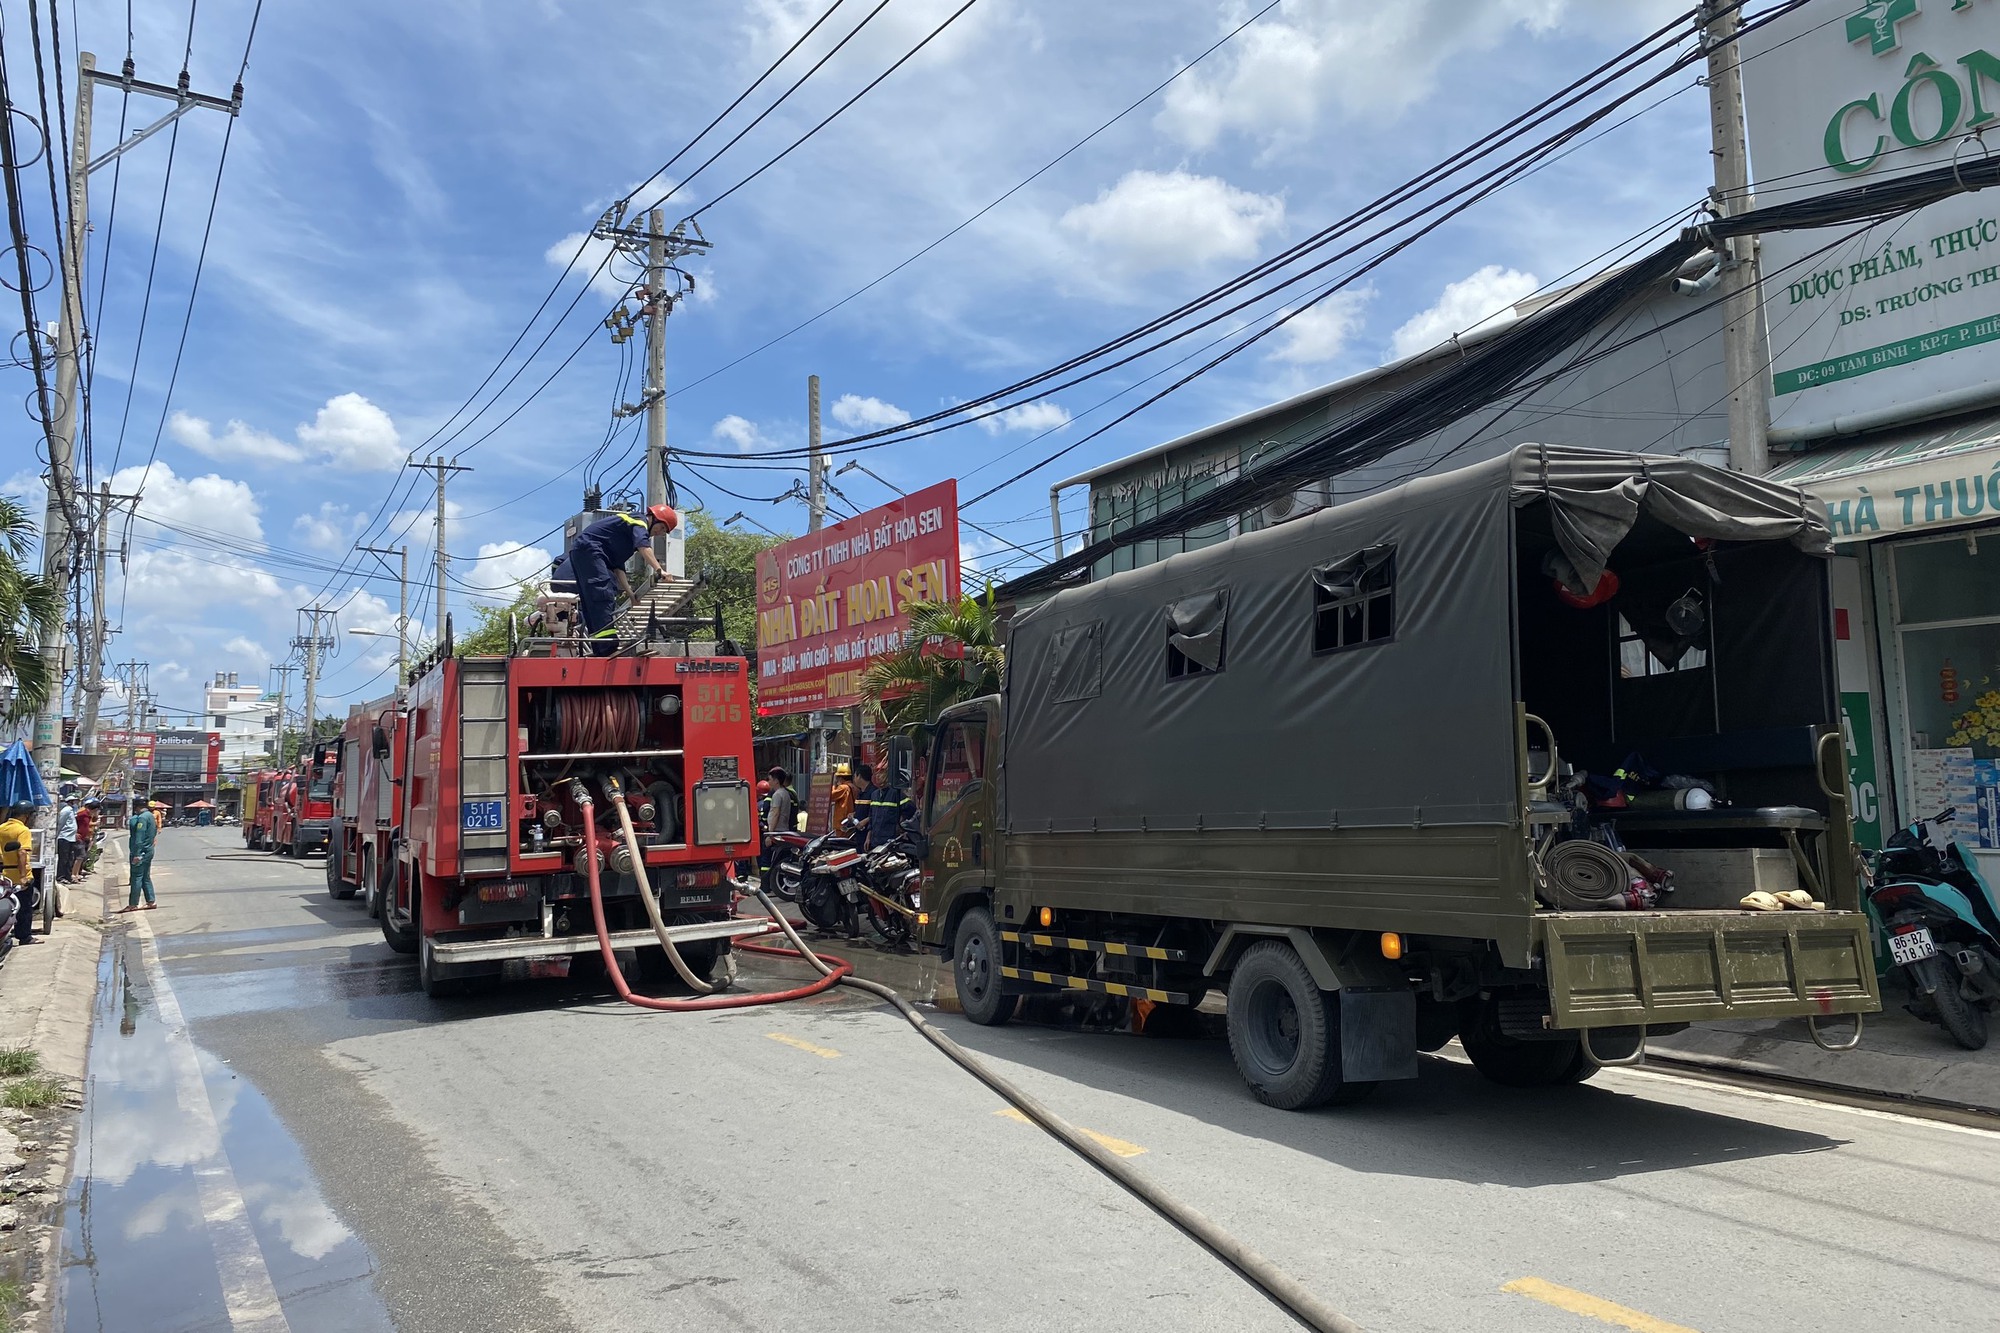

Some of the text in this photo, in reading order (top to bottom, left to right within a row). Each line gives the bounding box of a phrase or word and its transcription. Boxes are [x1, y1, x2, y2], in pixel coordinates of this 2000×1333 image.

[1787, 218, 1998, 304] DƯỢC PHẨM, THỰC
[1839, 265, 2000, 327] DS: TRƯƠNG TH
[1821, 366, 1836, 378] 09
[1838, 356, 1868, 374] TAM
[1872, 345, 1909, 366] BÌNH
[1826, 486, 1881, 538] HÀ
[786, 506, 943, 580] CÔNG TY TNHH NHÀ ĐẤT HOA SEN
[760, 559, 948, 648] NHÀ ĐẤT HOA SEN
[763, 659, 777, 677] MUA
[782, 651, 796, 674] BÁN
[834, 639, 851, 663] NHÀ
[851, 632, 867, 660] ĐẤT
[691, 704, 742, 723] 0215
[156, 735, 193, 744] Jollibee
[467, 815, 498, 828] 0215
[470, 802, 494, 815] 51F
[1893, 931, 1925, 949] 86-B2
[1894, 943, 1933, 963] 518.18
